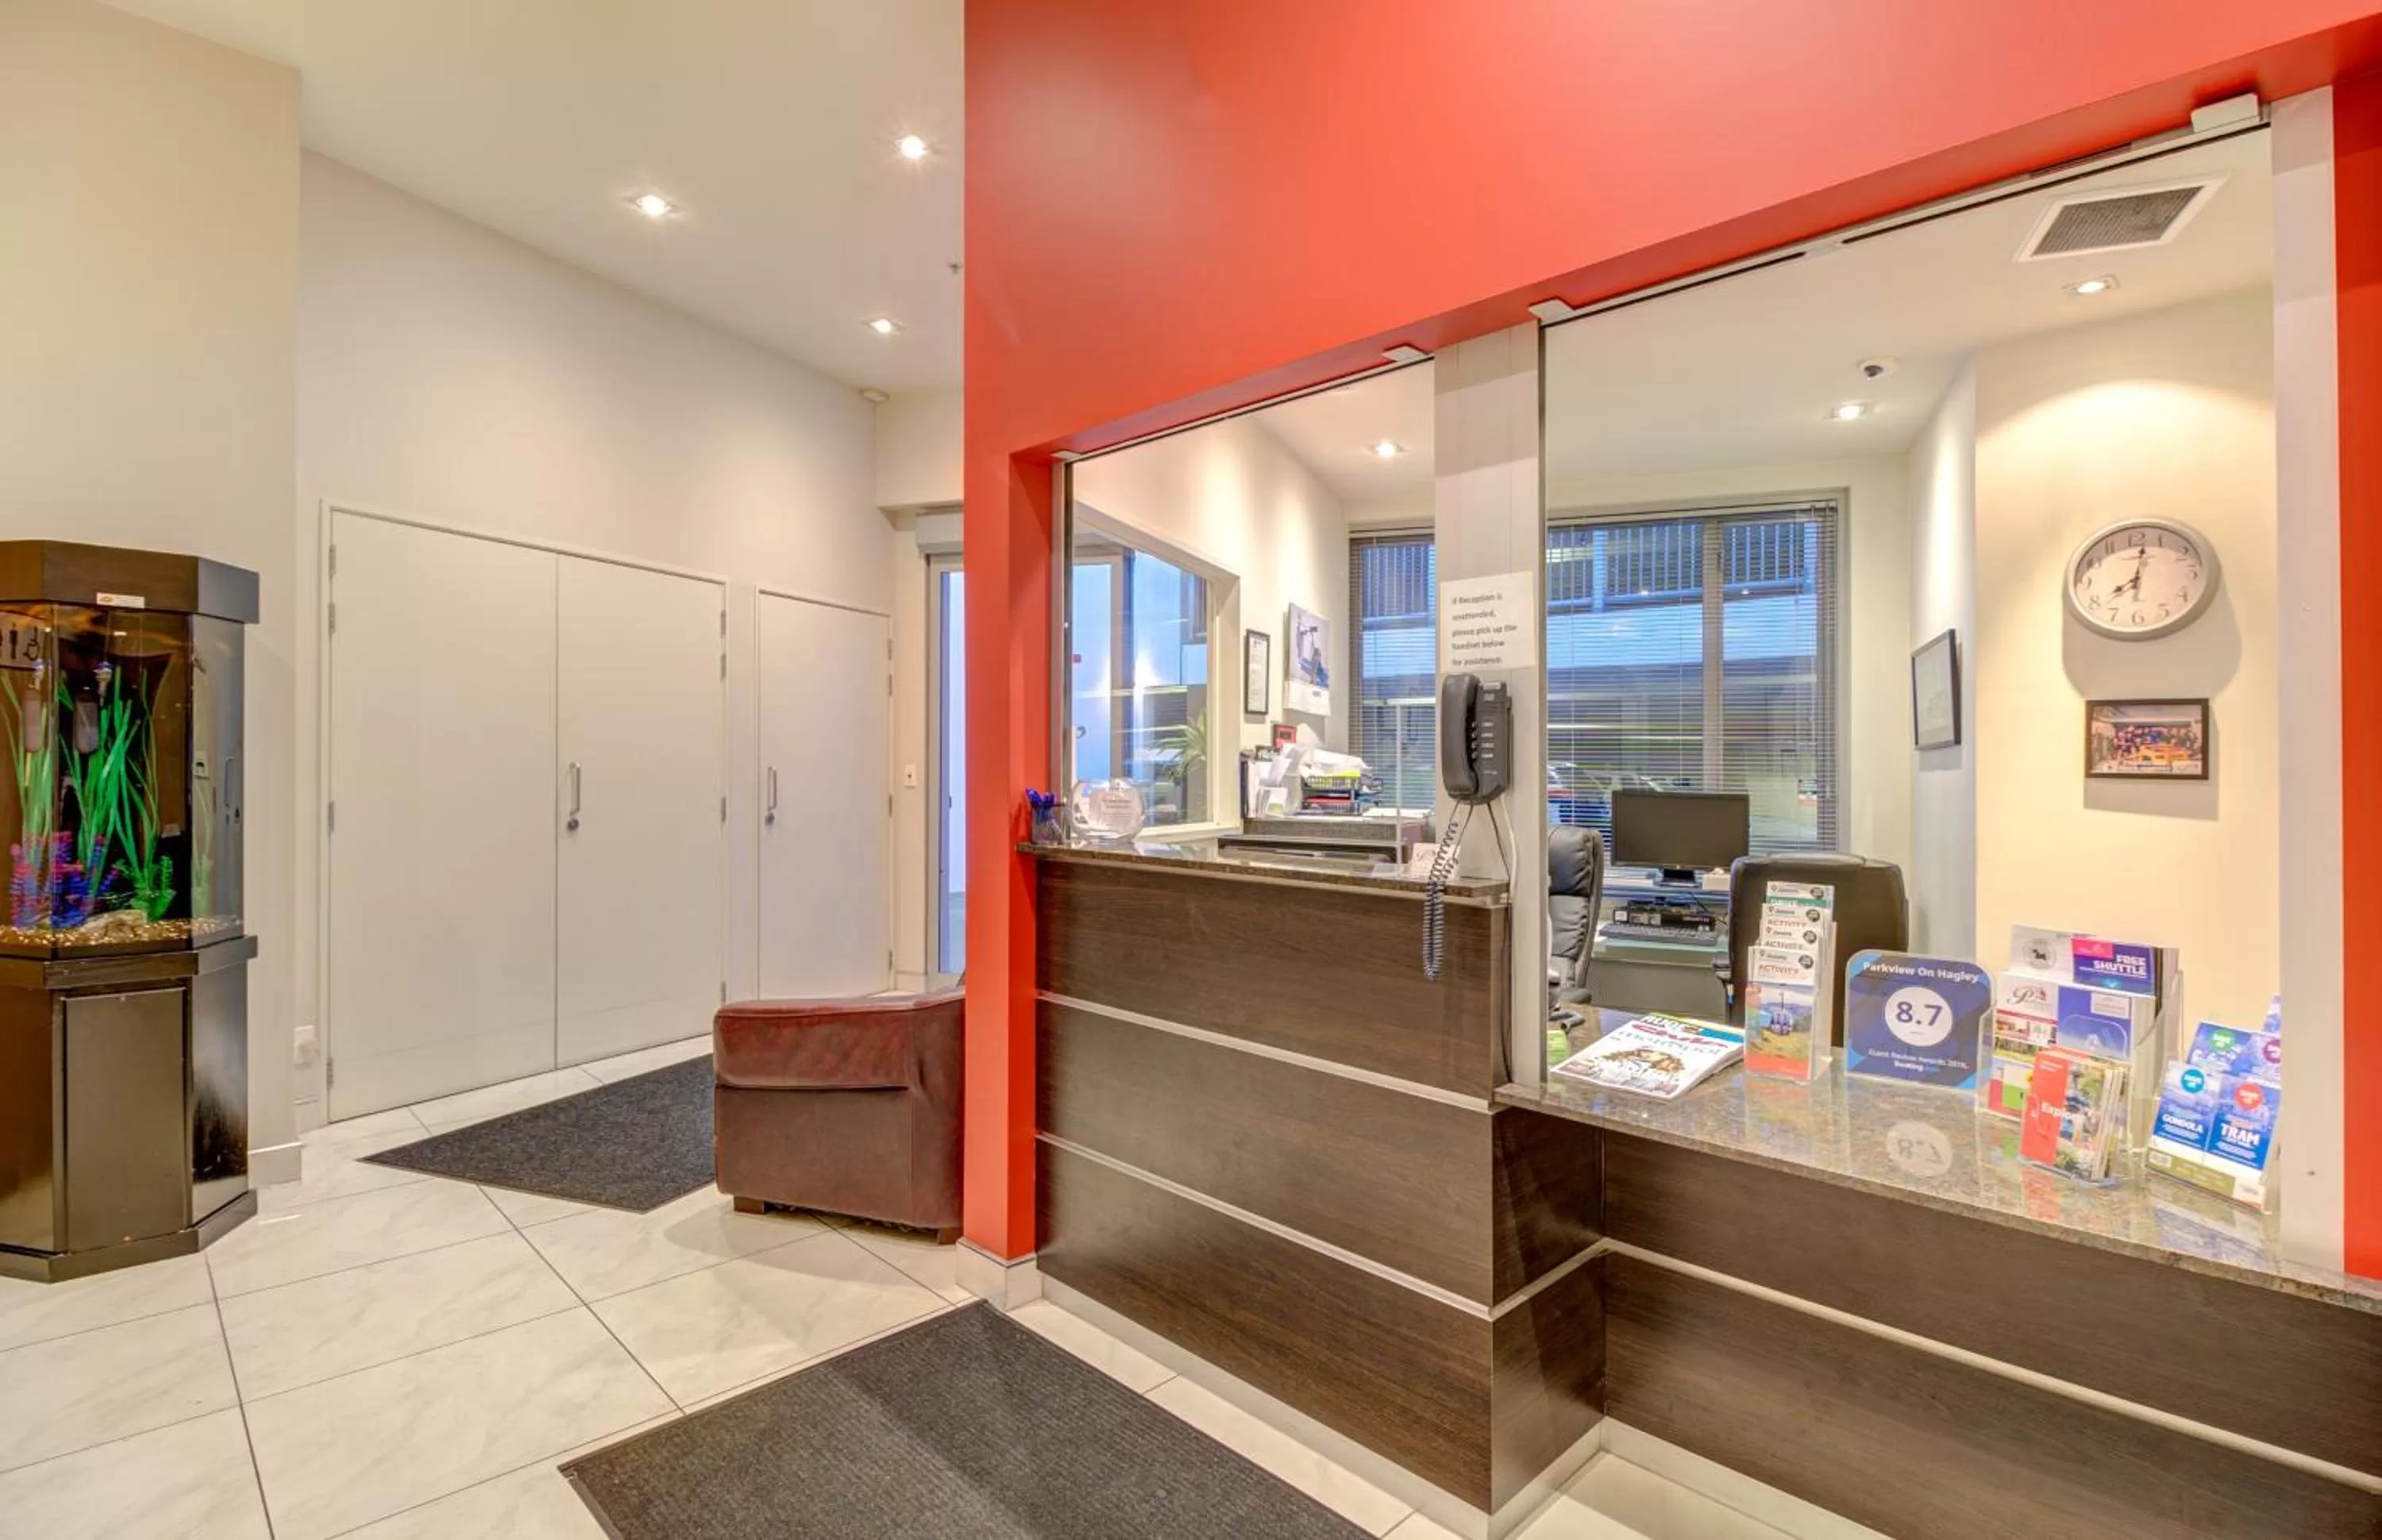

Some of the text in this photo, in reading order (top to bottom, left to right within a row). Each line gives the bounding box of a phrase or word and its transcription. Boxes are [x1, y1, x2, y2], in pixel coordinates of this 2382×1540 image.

[2105, 539, 2115, 555] 11
[2128, 533, 2145, 547] 12
[2158, 534, 2162, 547] 1
[2176, 545, 2189, 561] 2
[2187, 564, 2199, 580] 3
[2082, 576, 2092, 591] 9
[2177, 586, 2188, 603] 4
[2089, 595, 2101, 610] 8
[2108, 607, 2119, 622] 7
[2132, 610, 2145, 625] 6
[2157, 603, 2170, 618] 5
[2092, 960, 2148, 976] SHUTTLE
[2116, 954, 2147, 967] FREE
[1864, 961, 1979, 984] Parkview On Hagley
[1894, 1001, 1944, 1027] 8.7
[2220, 1122, 2261, 1145] TRAM
